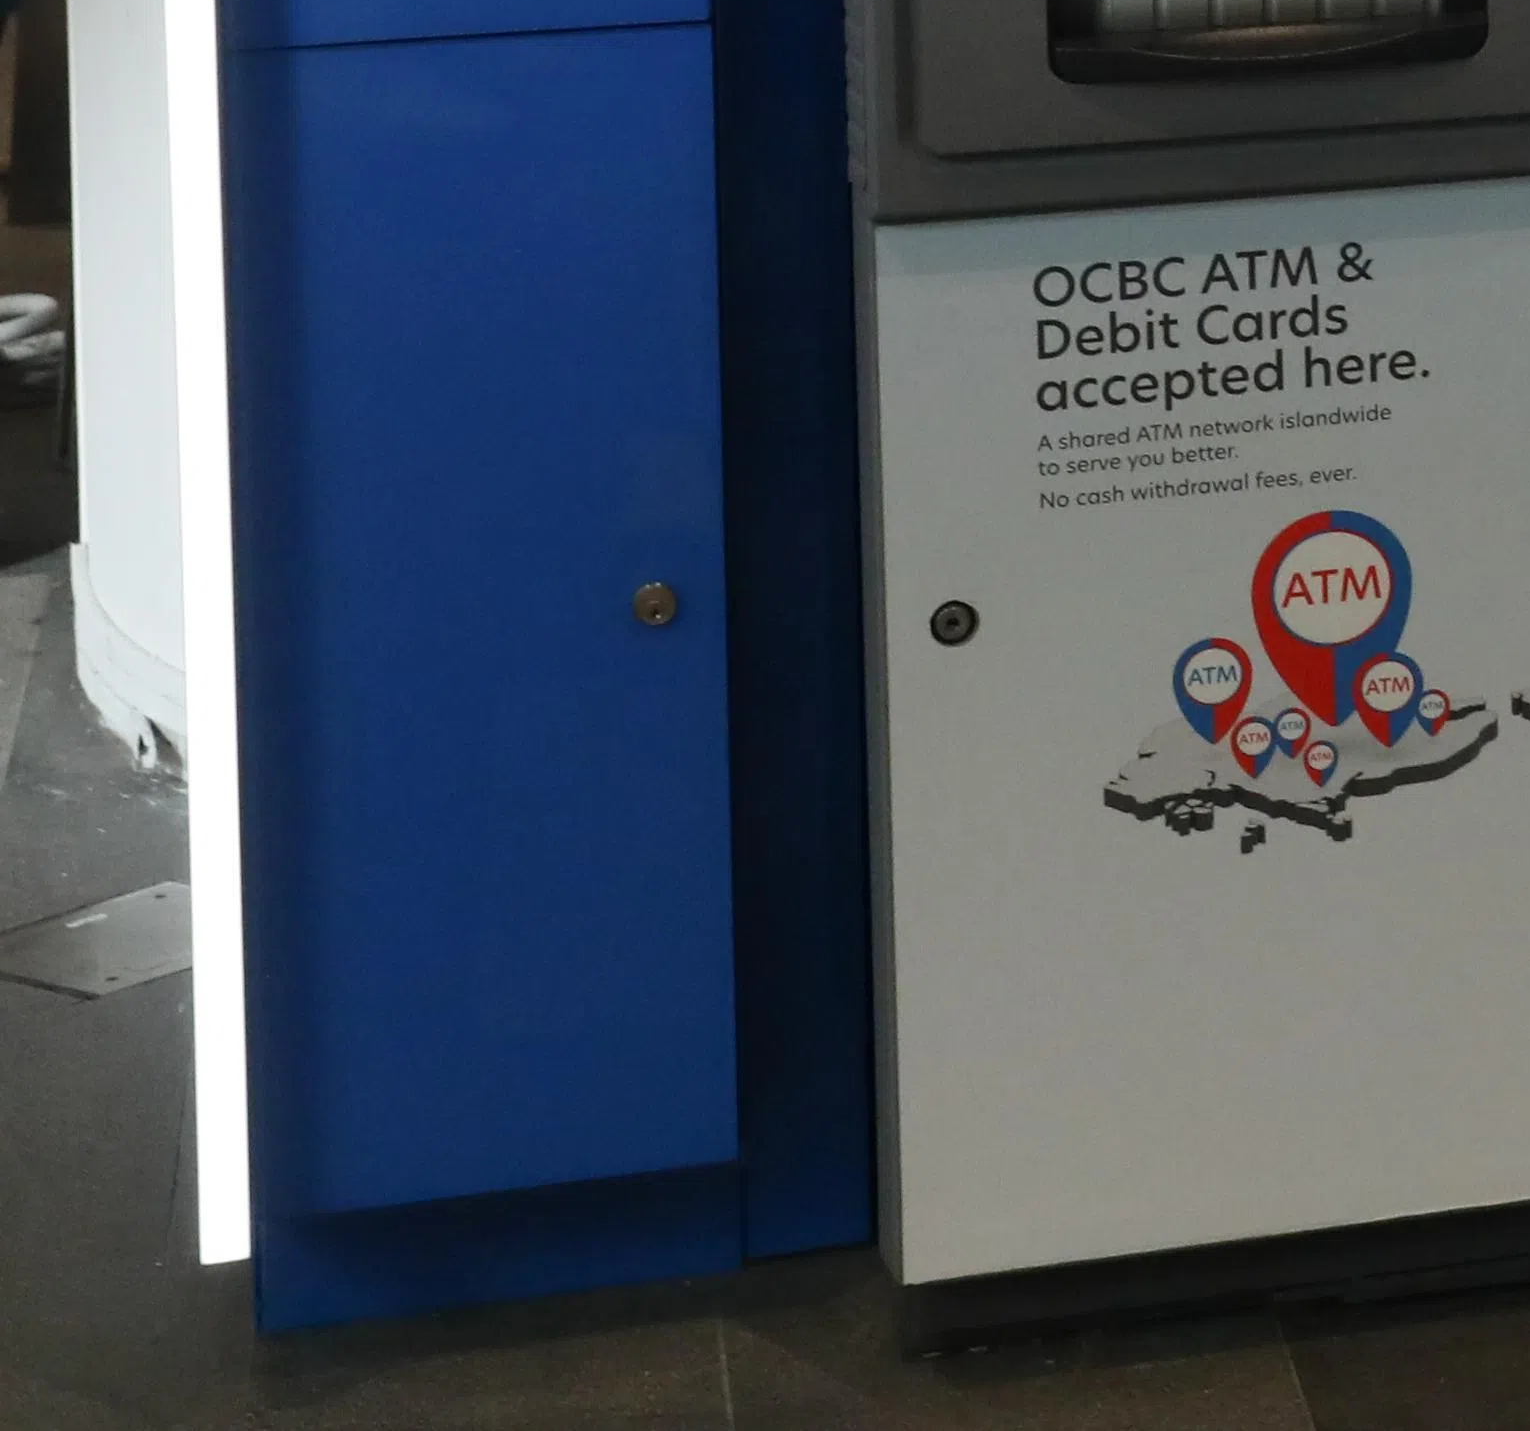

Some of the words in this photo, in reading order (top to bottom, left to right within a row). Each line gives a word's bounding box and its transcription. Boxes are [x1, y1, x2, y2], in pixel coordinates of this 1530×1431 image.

[1032, 257, 1187, 307] OCBC
[1201, 247, 1318, 294] ATM
[1337, 241, 1373, 282] &
[1036, 309, 1180, 360] Debit
[1196, 296, 1348, 345] Cards
[1036, 349, 1285, 411] accepted
[1304, 343, 1431, 388] here.
[1038, 435, 1053, 452] A
[1058, 425, 1131, 451] shared
[1136, 423, 1184, 443] ATM
[1189, 414, 1274, 439] network
[1279, 404, 1392, 432] islandwide
[1038, 460, 1057, 476] to
[1061, 455, 1122, 474] serve
[1127, 452, 1166, 472] you
[1171, 442, 1240, 466] better.
[1038, 491, 1070, 509] No
[1076, 485, 1126, 506] cash
[1131, 475, 1250, 503] withdrawal
[1254, 470, 1304, 493] fees,
[1309, 465, 1358, 488] ever.
[1281, 565, 1384, 609] ATM
[1187, 665, 1239, 688] ATM
[1365, 676, 1410, 696] ATM
[1238, 732, 1269, 746] ATM
